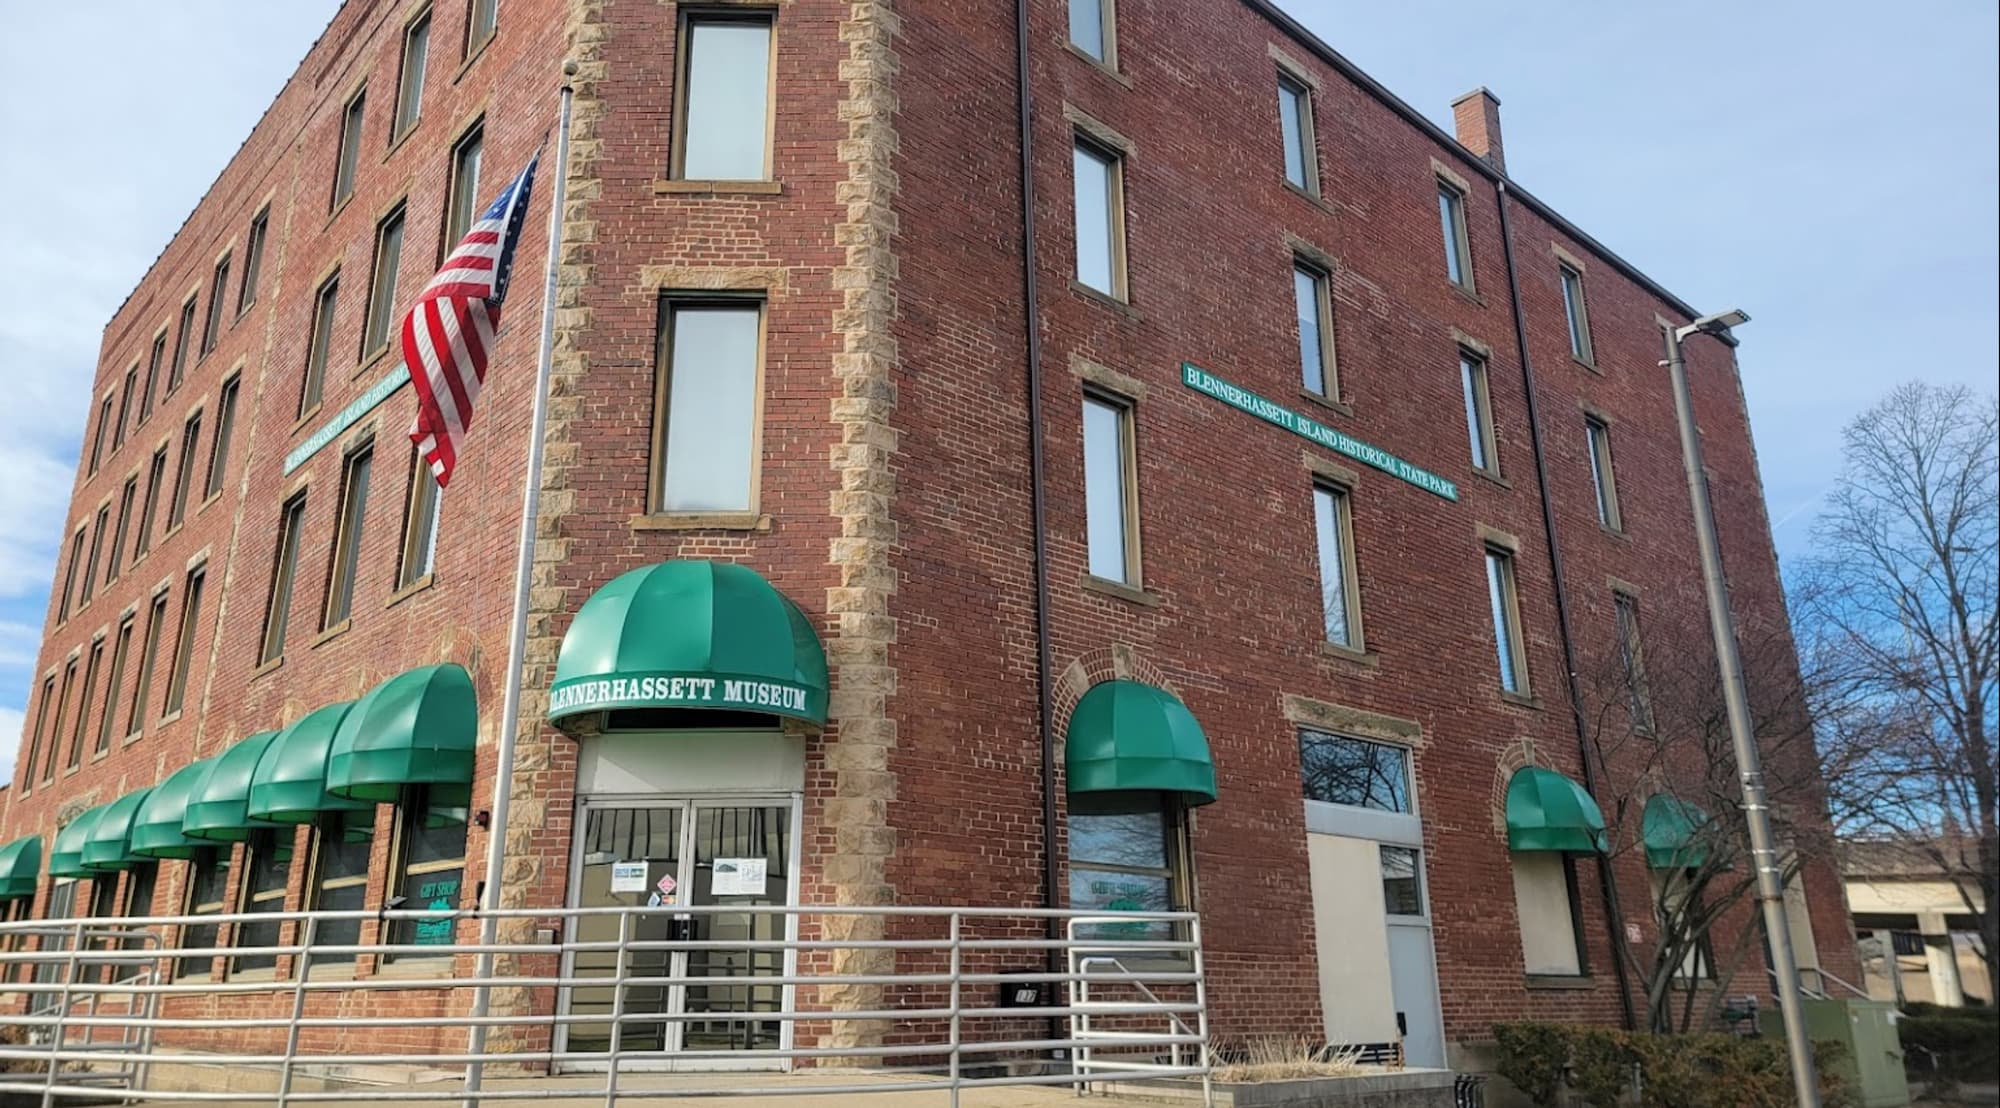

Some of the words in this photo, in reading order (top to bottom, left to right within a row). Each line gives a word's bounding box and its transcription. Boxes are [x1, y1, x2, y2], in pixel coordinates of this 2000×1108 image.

[1187, 367, 1293, 427] BLENNERHASSETT
[1297, 416, 1337, 449] ISLAND
[1338, 434, 1399, 474] HISTORICAL
[1399, 459, 1431, 488] STATE
[1429, 473, 1455, 497] PARK
[723, 679, 806, 711] MUSEUM
